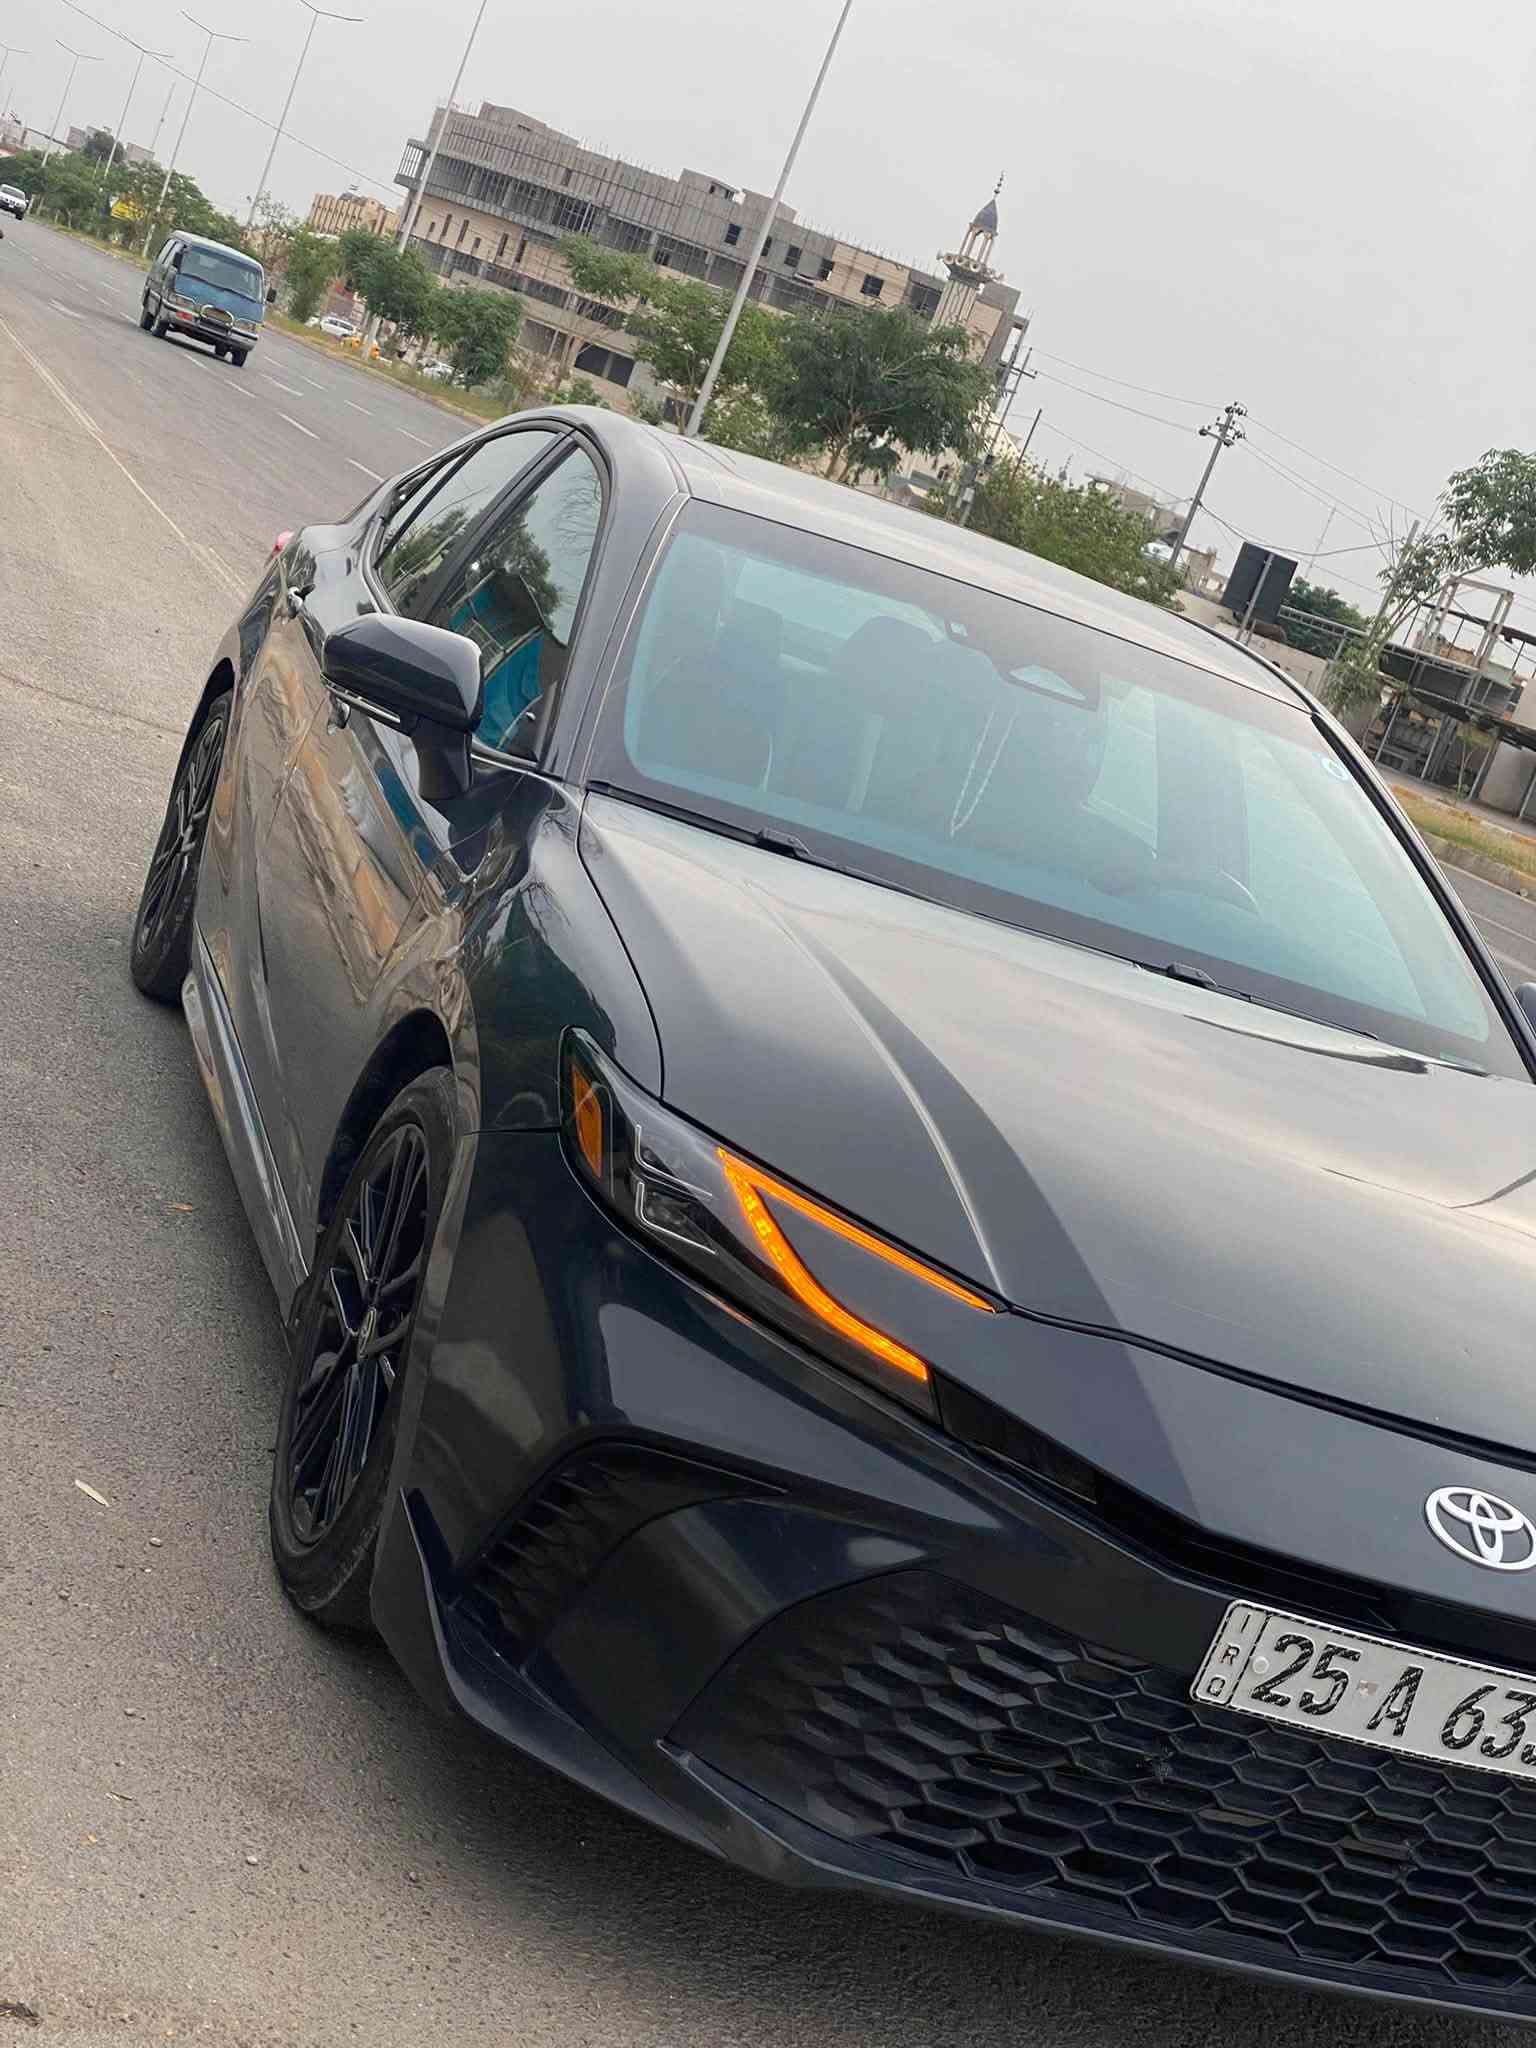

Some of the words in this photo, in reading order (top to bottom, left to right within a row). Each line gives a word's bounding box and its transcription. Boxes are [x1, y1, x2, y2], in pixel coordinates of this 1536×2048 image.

[1250, 1634, 1361, 1715] 25
[1366, 1665, 1424, 1736] A
[1440, 1684, 1536, 1767] 63
